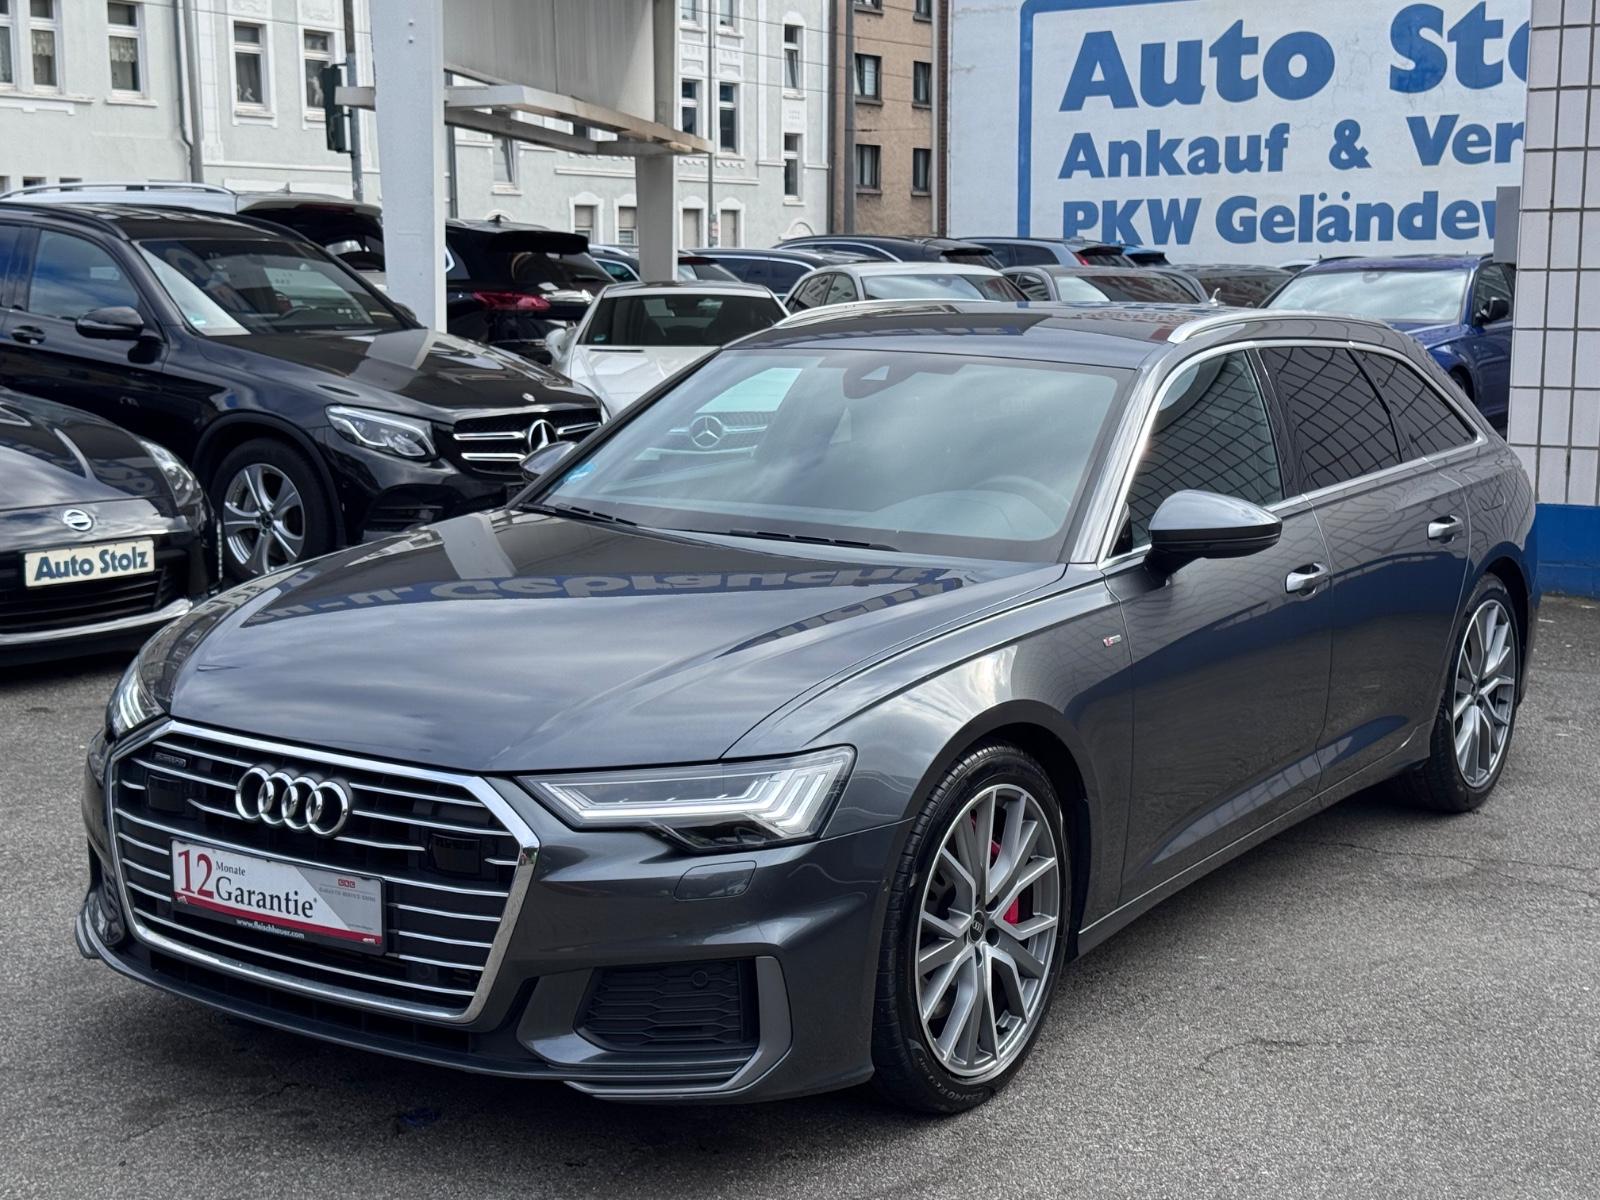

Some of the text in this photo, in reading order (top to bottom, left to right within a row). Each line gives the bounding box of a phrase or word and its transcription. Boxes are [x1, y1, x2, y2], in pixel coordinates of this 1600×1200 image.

[1059, 19, 1335, 112] Auto
[1058, 122, 1290, 179] Ankauf
[1329, 119, 1372, 170] &
[1063, 198, 1202, 246] PKW
[34, 547, 148, 581] Auto Stolz
[178, 849, 214, 899] 12
[216, 861, 246, 876] Monate
